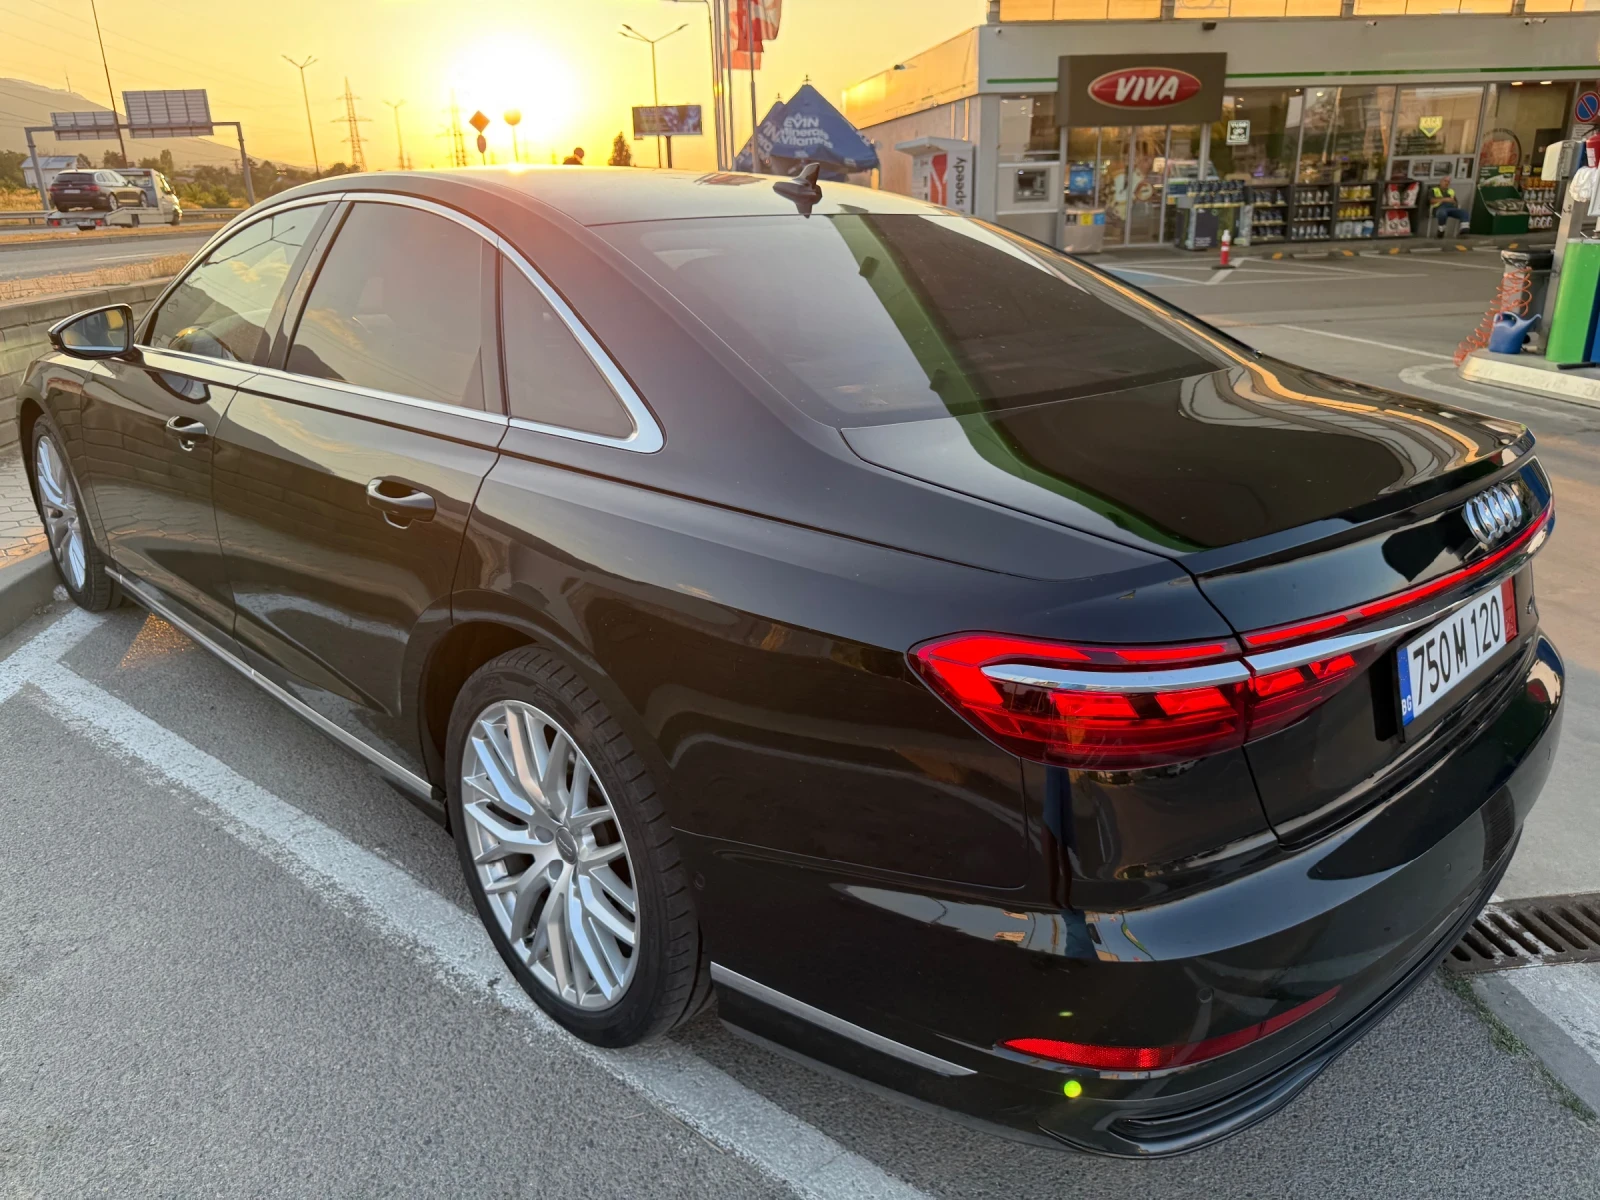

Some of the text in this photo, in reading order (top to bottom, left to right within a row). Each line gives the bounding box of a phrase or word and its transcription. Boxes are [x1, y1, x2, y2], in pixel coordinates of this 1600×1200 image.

[1115, 75, 1179, 102] VIVA
[953, 157, 967, 205] speedy
[1401, 695, 1412, 716] BG
